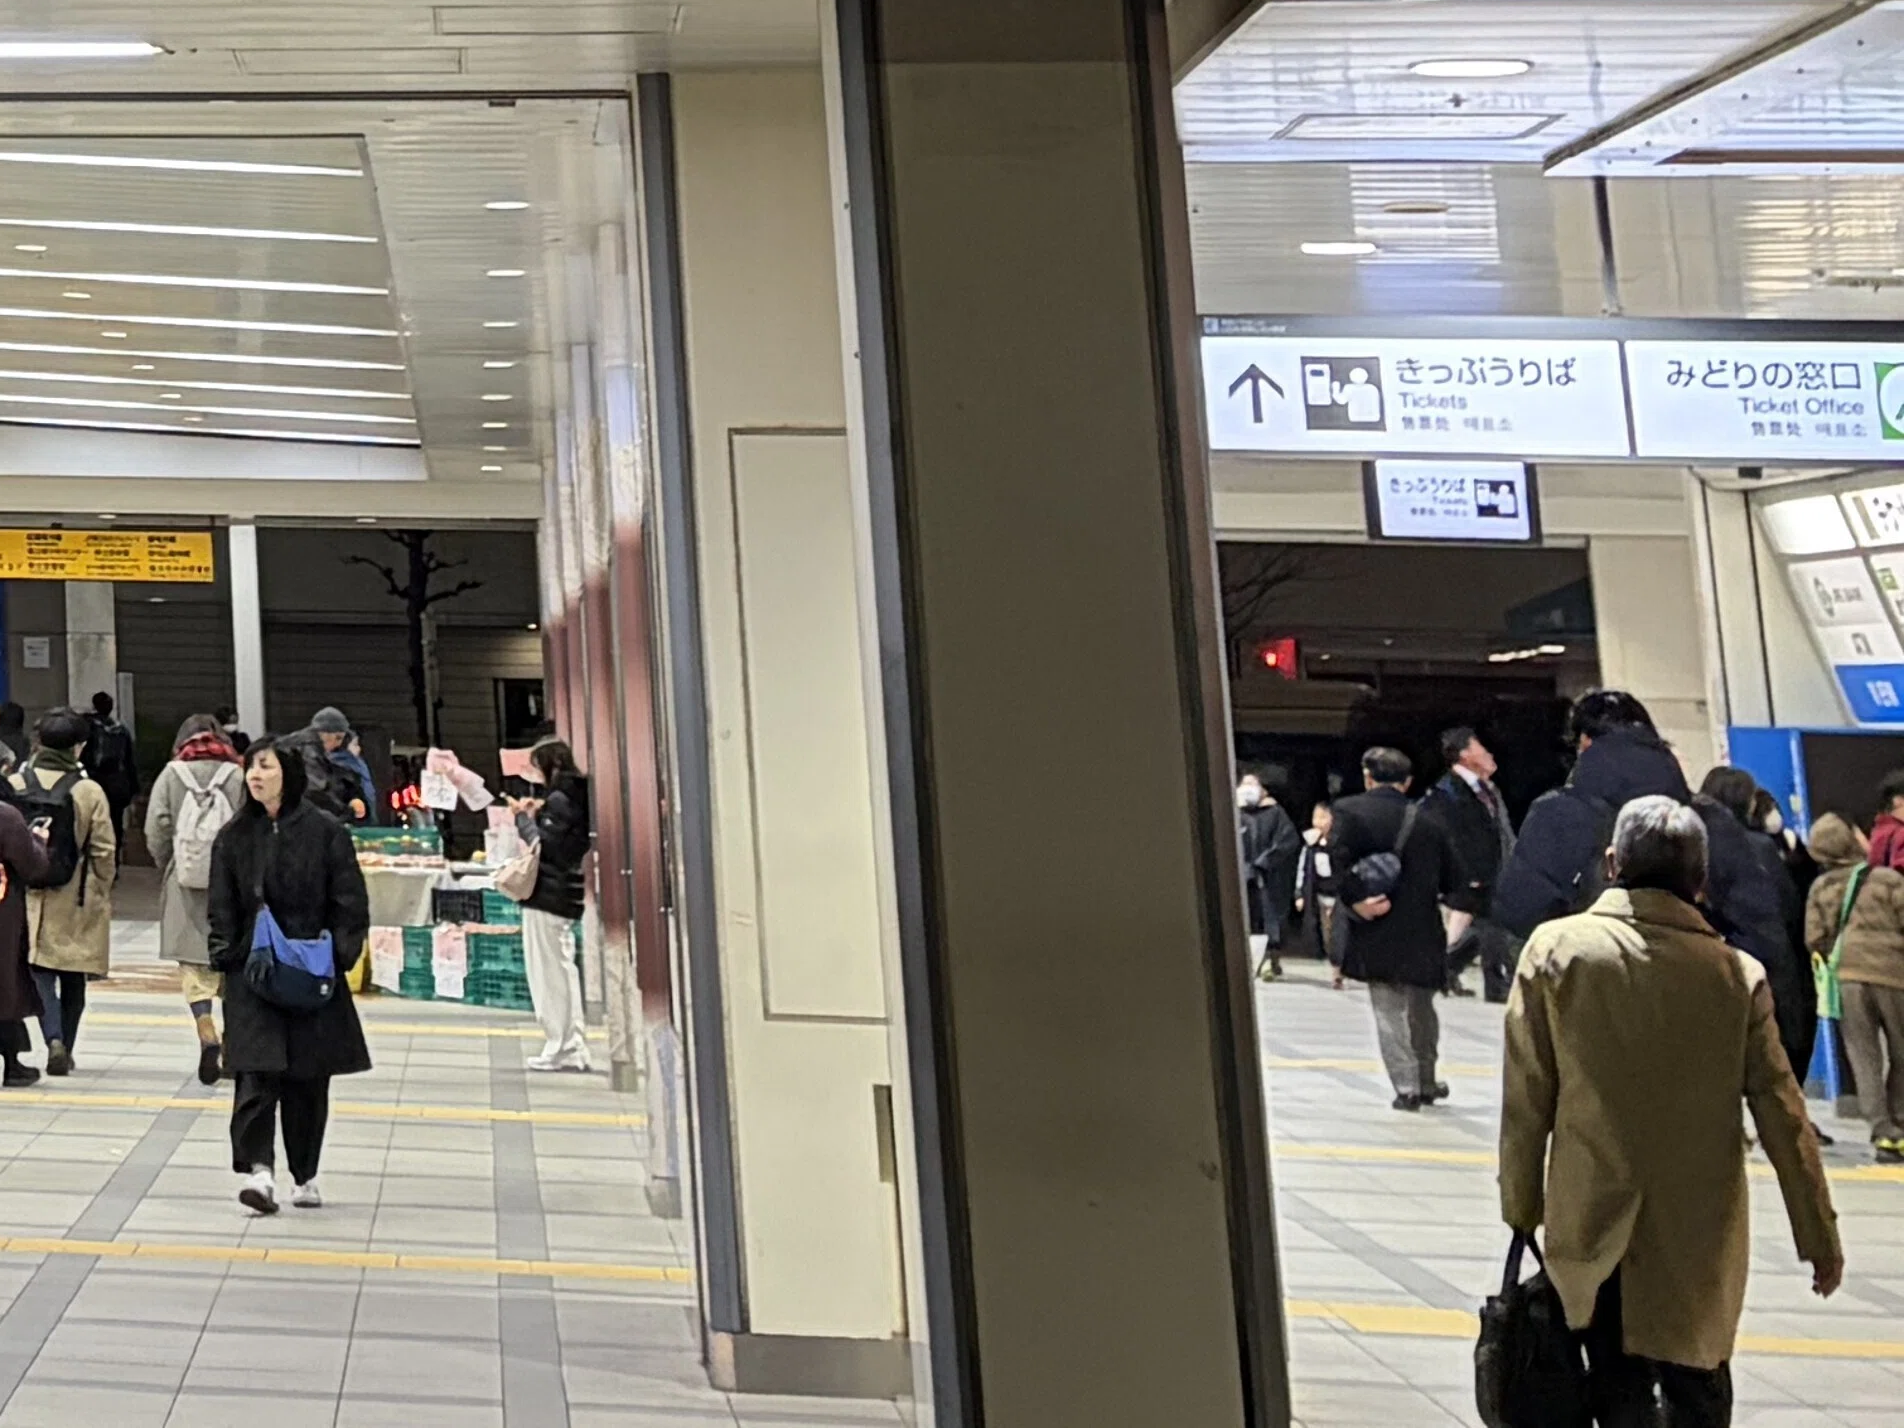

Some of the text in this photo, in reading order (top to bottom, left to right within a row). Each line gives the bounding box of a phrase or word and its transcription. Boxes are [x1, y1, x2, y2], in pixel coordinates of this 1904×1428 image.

[1396, 357, 1576, 386] きっぷうりば
[1666, 359, 1861, 390] みどりの窓口
[1398, 392, 1468, 410] Tickets
[1737, 397, 1865, 415] Ticket Office
